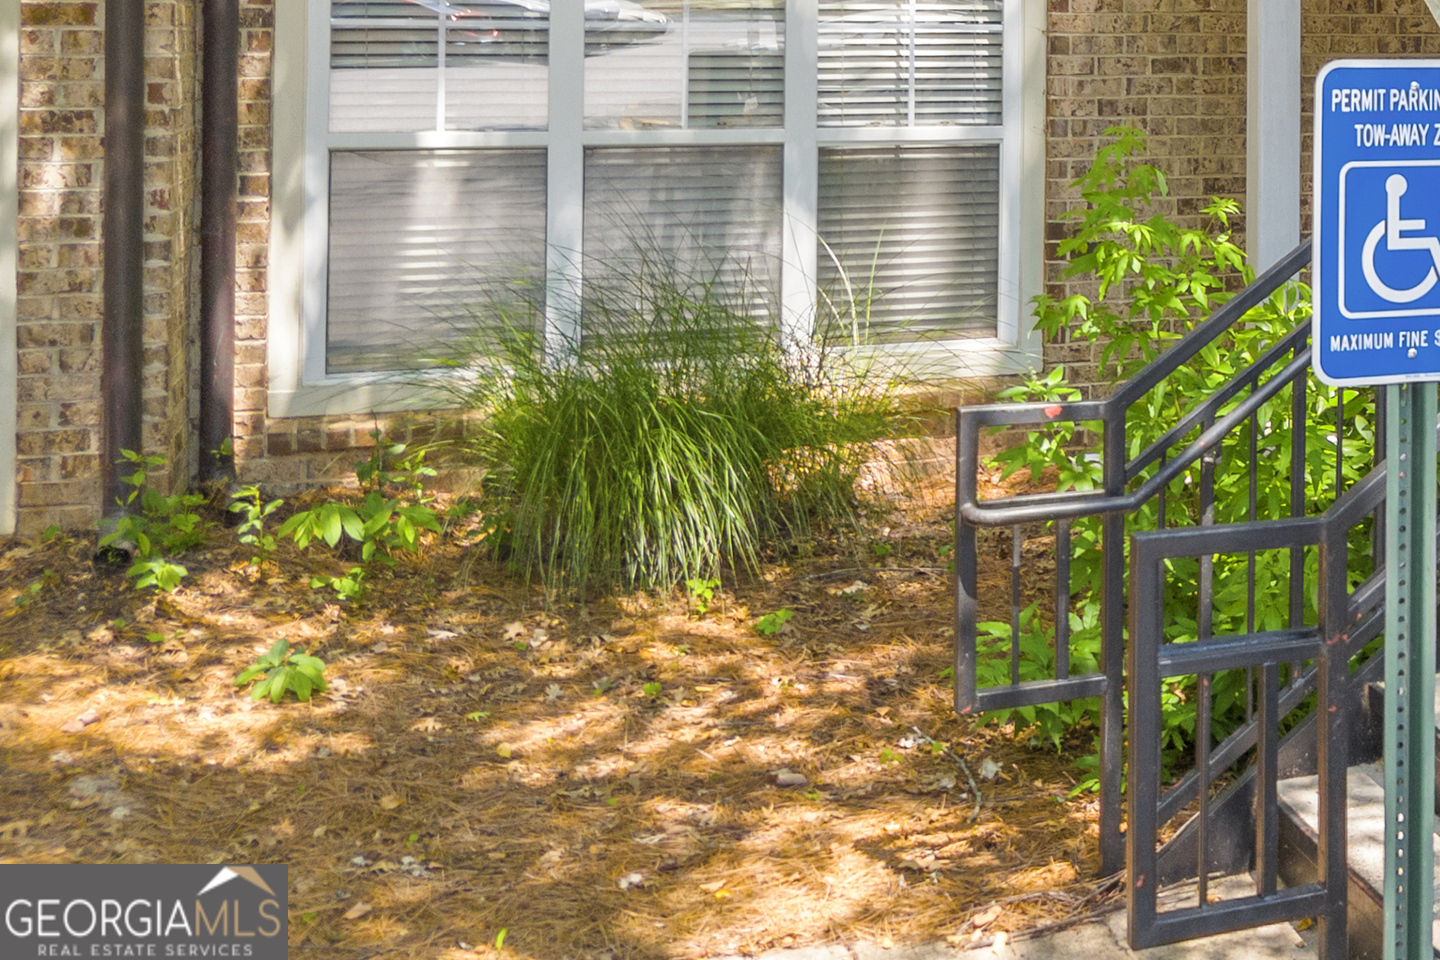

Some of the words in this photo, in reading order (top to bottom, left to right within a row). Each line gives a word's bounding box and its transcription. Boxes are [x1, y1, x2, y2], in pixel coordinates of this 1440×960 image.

[1331, 89, 1386, 112] PERMIT
[1354, 123, 1430, 147] TOW-AWAY
[1330, 332, 1394, 352] MAXIMUM
[1398, 330, 1429, 348] FINE
